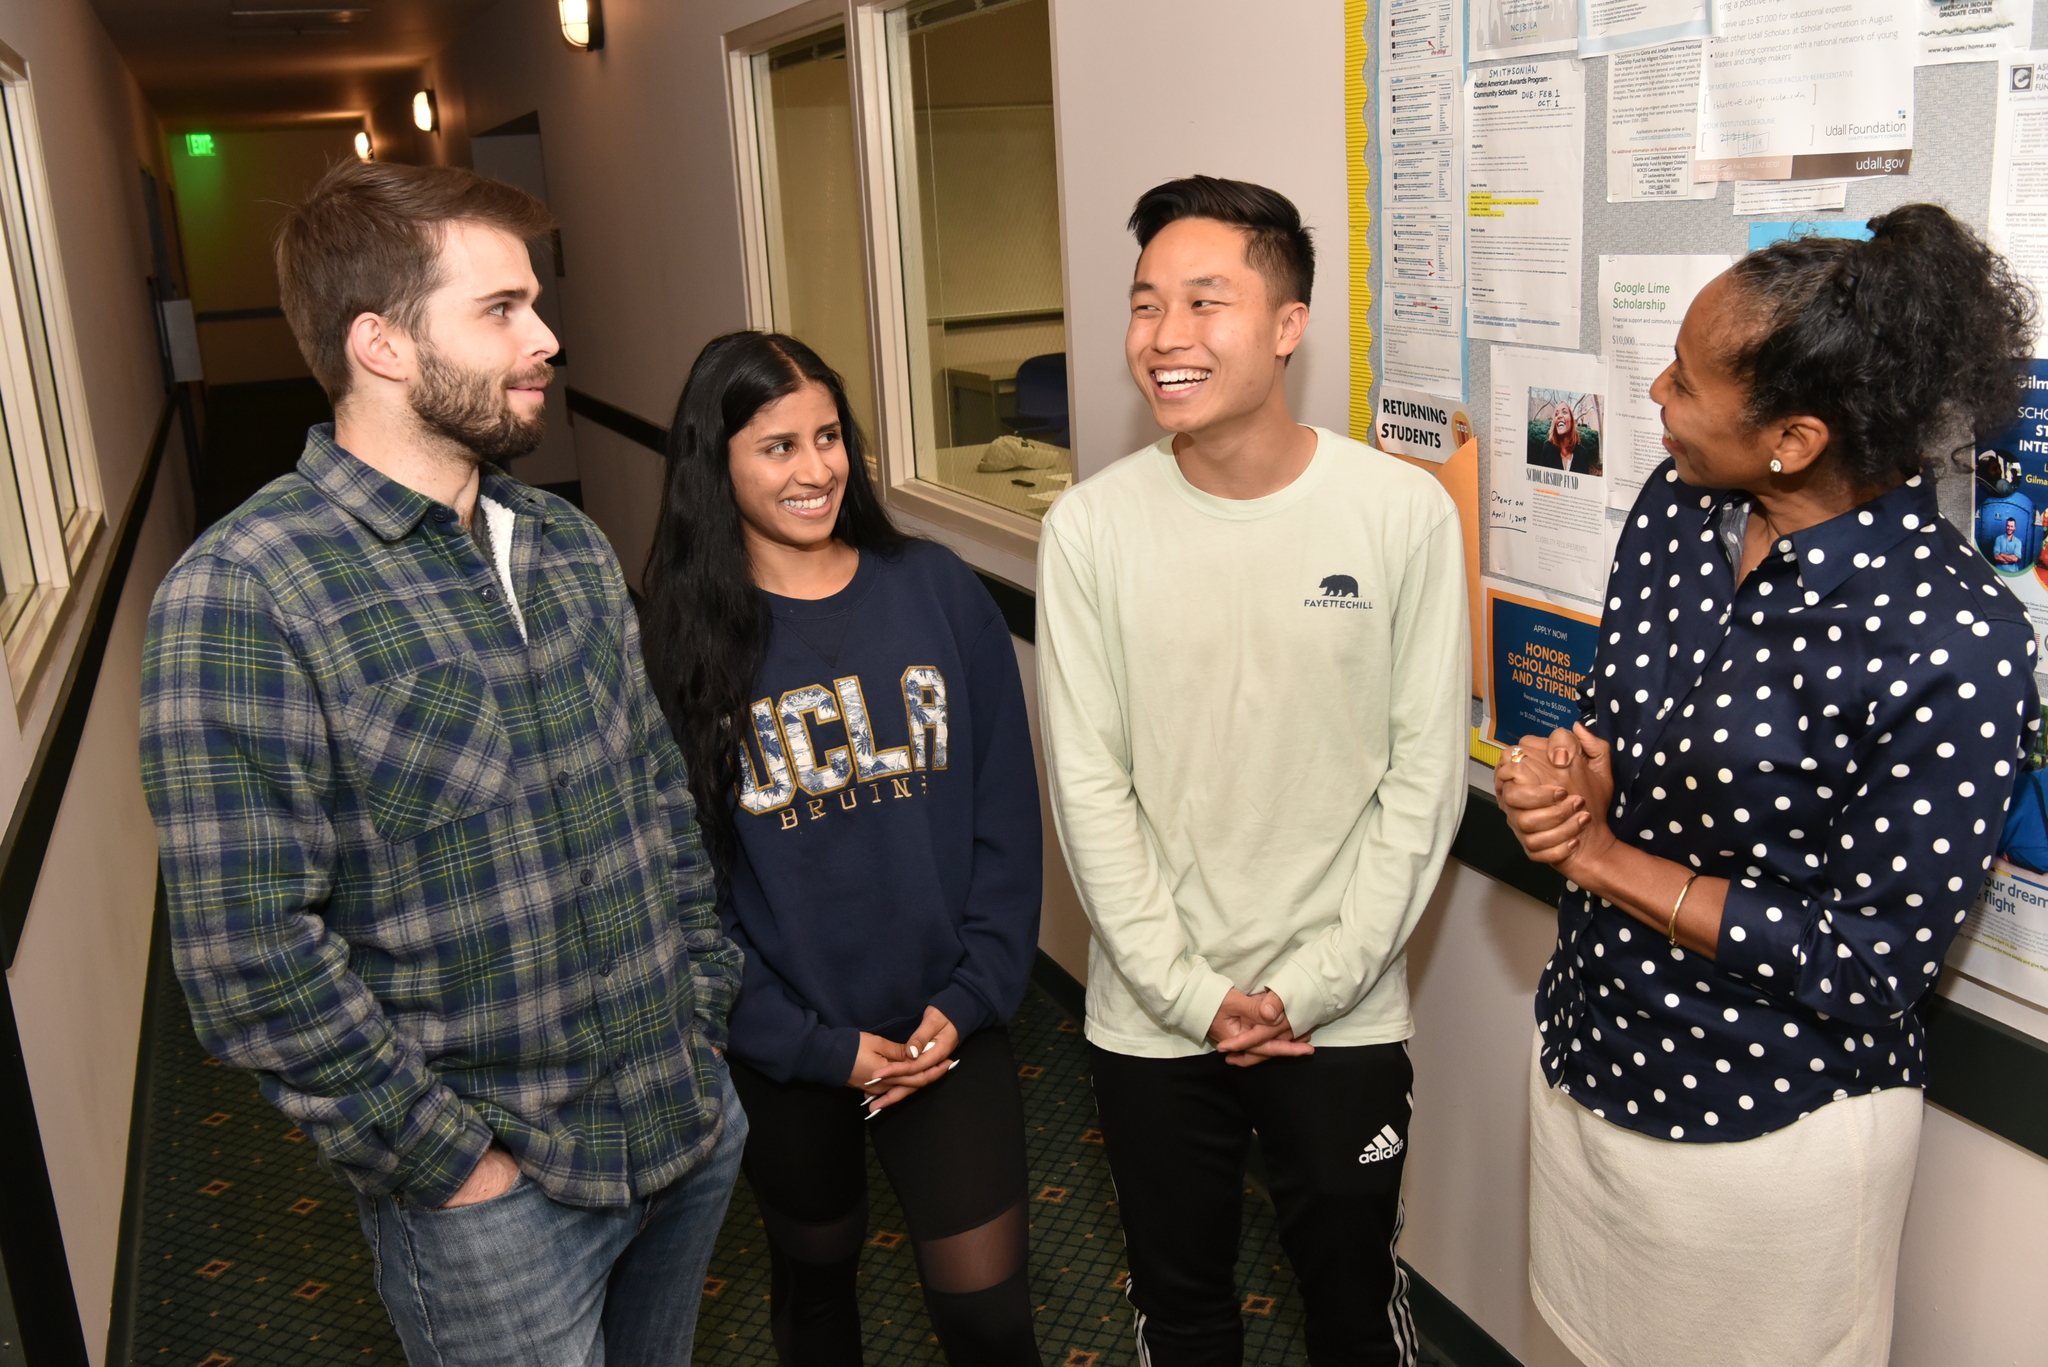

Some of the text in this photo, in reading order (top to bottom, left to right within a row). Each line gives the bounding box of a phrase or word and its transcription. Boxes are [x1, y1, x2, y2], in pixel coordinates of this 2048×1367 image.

[1938, 8, 1967, 18] GRADUATE
[1940, 0, 1993, 12] AMERICAN INDIAN
[1756, 14, 1777, 24] $7,000
[1790, 8, 1824, 19] educational
[1825, 4, 1852, 15] expenses
[1715, 36, 1728, 44] Meet
[1748, 32, 1762, 40] Udall
[1764, 29, 1790, 38] Scholars
[1801, 24, 1822, 33] Scholar
[1824, 20, 1858, 30] Orientation
[1869, 14, 1893, 26] August
[1714, 51, 1729, 59] Make
[1735, 48, 1755, 56] lifelong
[1757, 44, 1792, 54] connection
[1793, 41, 1807, 50] with
[1814, 37, 1837, 47] national
[1839, 34, 1864, 44] network
[1866, 32, 1875, 41] of
[1876, 31, 1898, 42] young
[1928, 43, 1996, 53] www.aigc.com/home.asp
[1714, 60, 1732, 68] leaders
[1745, 57, 1766, 65] change
[1768, 54, 1791, 62] makers
[1488, 65, 1538, 78] SMITHSONIAN
[1742, 79, 1766, 87] CONTACT
[1784, 75, 1809, 83] FACULTY
[1810, 70, 1853, 80] REPRESENTATIVE
[1474, 76, 1548, 88] Native American Awards Program
[1474, 90, 1497, 98] Community
[1522, 89, 1560, 99] DUE: FEB. 1
[1720, 120, 1750, 128] INSTITUTION'S
[1825, 122, 1906, 136] Udall Foundation
[1856, 157, 1904, 172] udall.gov
[1614, 282, 1670, 295] Google Lime
[1613, 298, 1666, 312] Scholarship
[1612, 336, 1635, 346] $10,000
[1383, 399, 1447, 425] RETURNING
[1381, 423, 1441, 448] STUDENTS
[2019, 440, 2048, 454] INTE
[1526, 468, 1578, 490] SCHOLARSHIP FUND
[1492, 510, 1506, 519] April
[1535, 535, 1587, 553] ELIGIBILITY REQUIREMENTS
[1304, 599, 1373, 609] FAYETTECHILL
[1533, 625, 1567, 641] APPLY NOW!
[1525, 642, 1570, 667] HONORS
[1512, 669, 1577, 701] AND STIPEND
[1523, 692, 1539, 703] Receive
[1551, 701, 1567, 712] $5,000
[1534, 707, 1559, 720] scholarships
[1541, 719, 1558, 729] research
[727, 666, 948, 816] UCLA
[1984, 890, 2015, 915] flight
[1359, 1139, 1404, 1164] adidas
